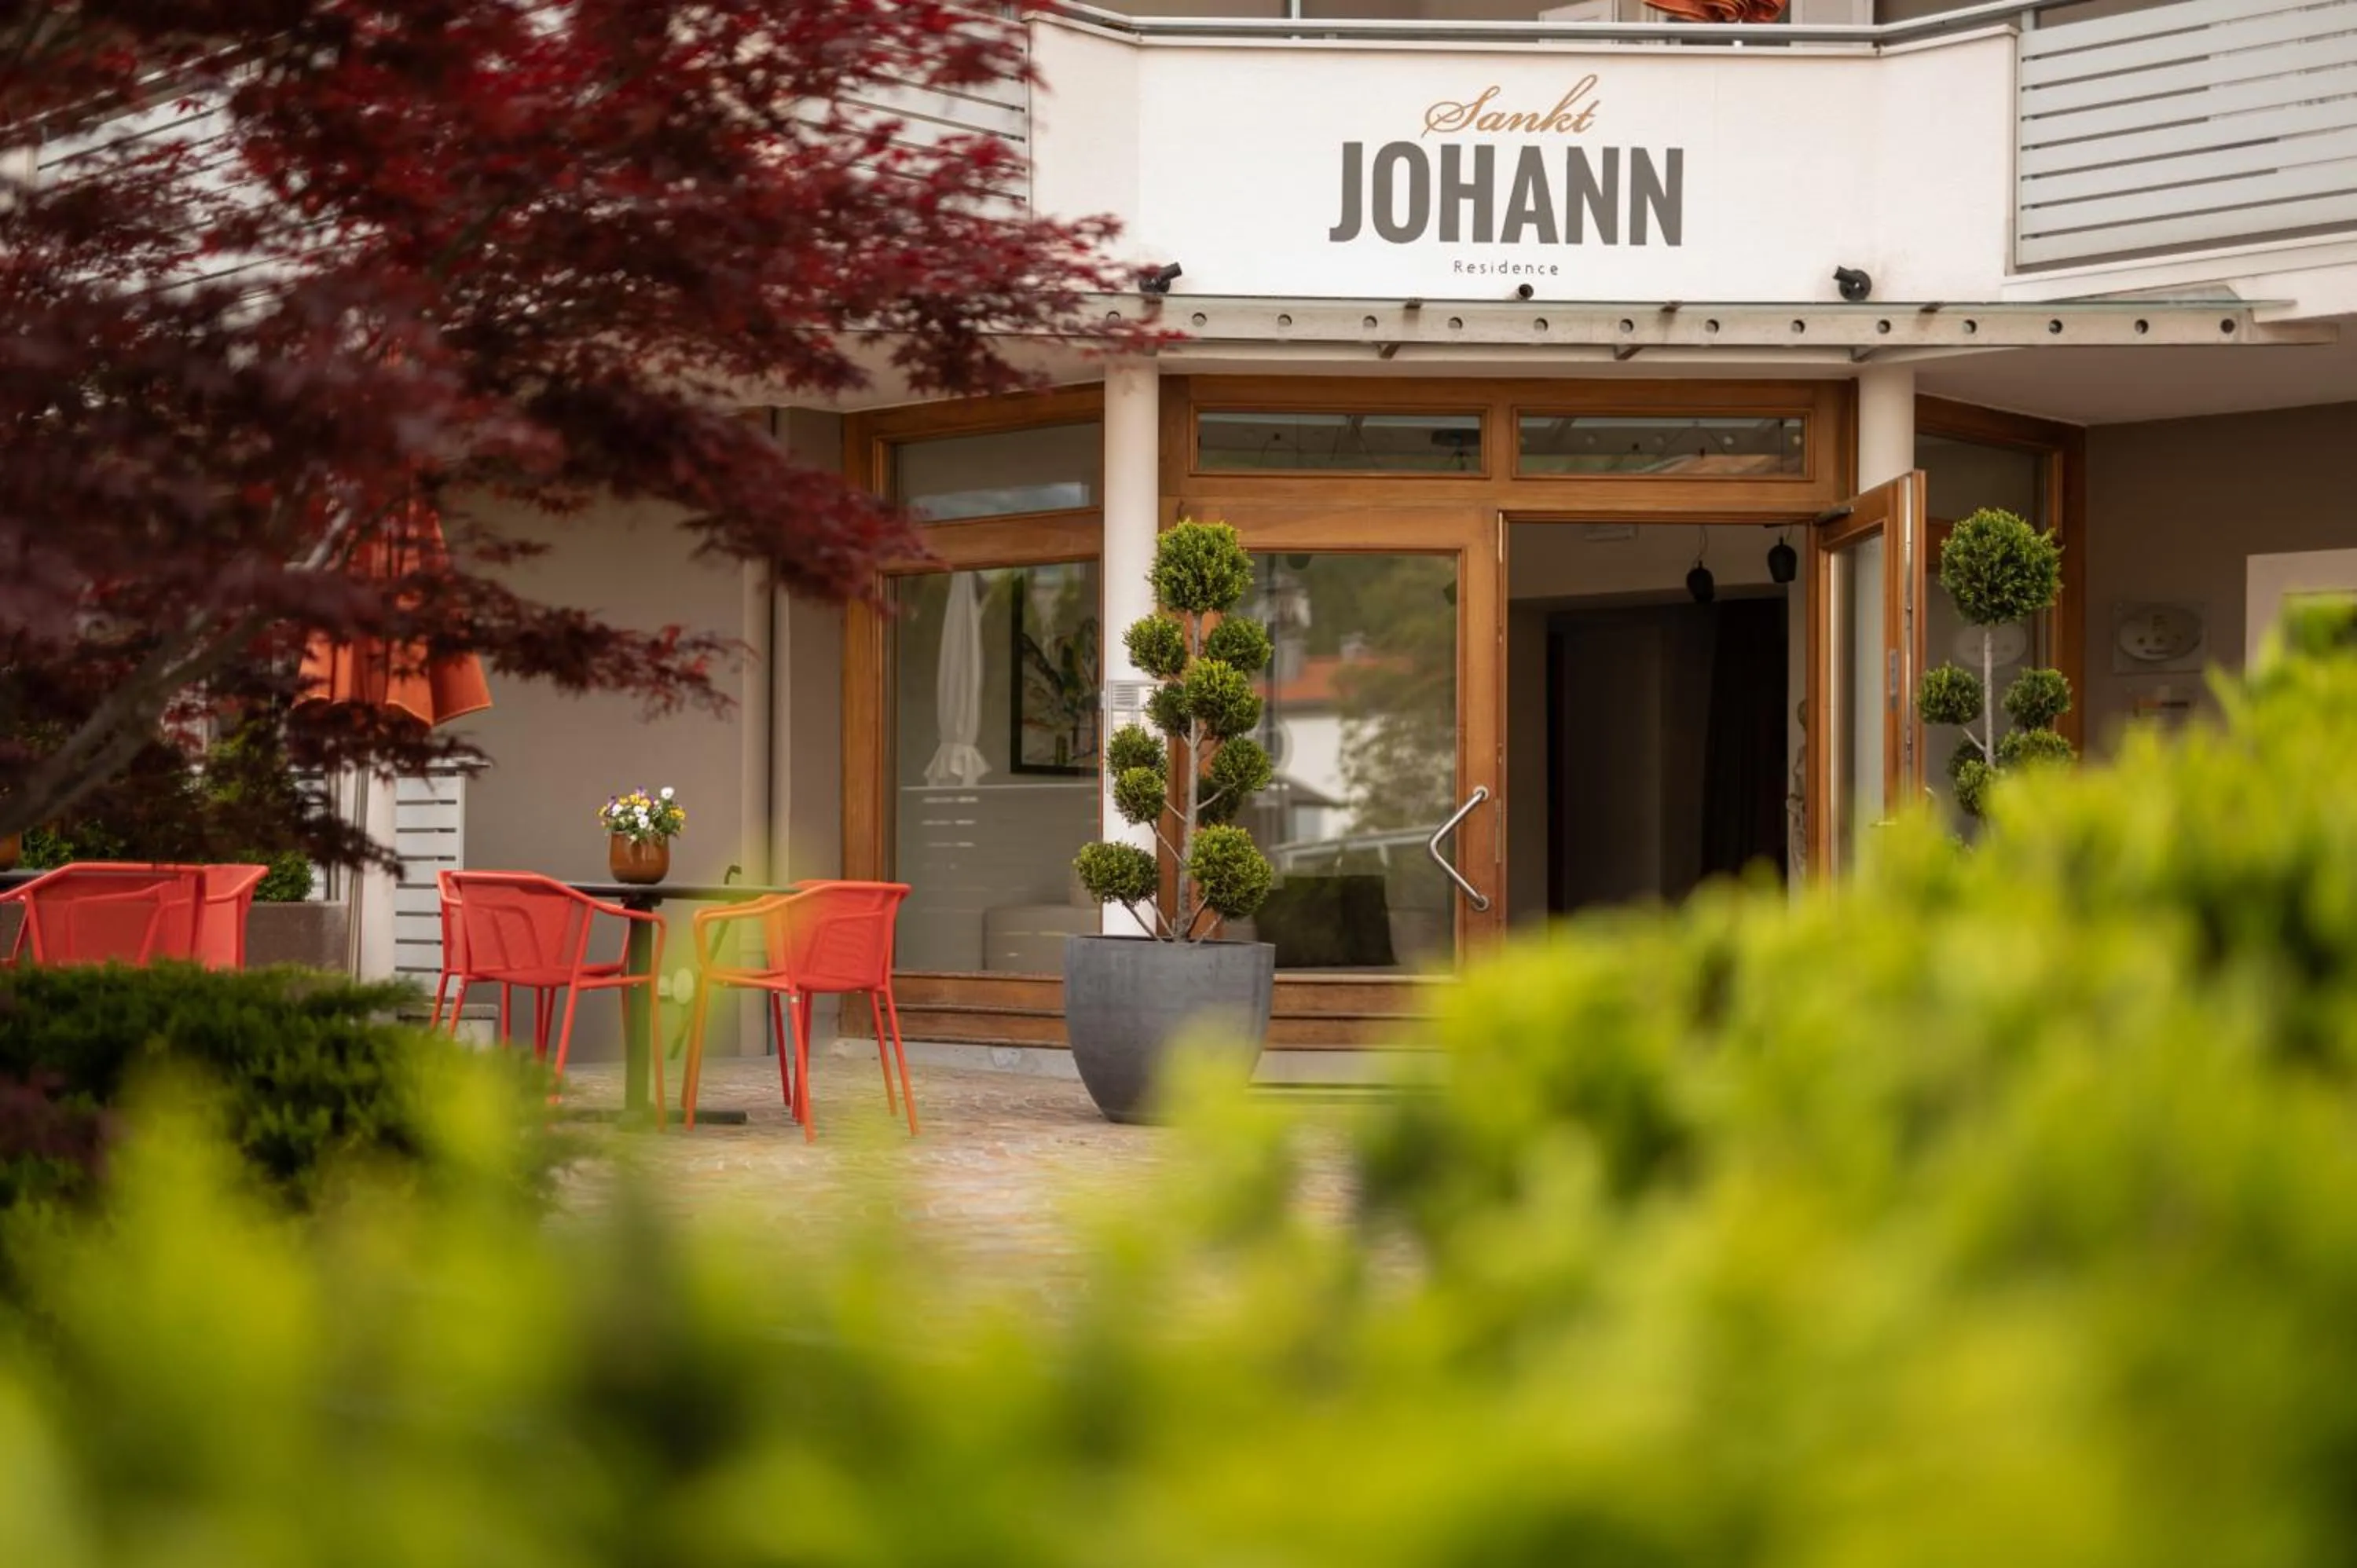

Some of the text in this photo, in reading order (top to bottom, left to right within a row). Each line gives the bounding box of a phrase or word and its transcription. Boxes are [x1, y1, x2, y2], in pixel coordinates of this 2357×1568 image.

[1420, 74, 1600, 138] Sankt
[1329, 141, 1684, 247] JOHANN
[1454, 260, 1558, 276] Residence
